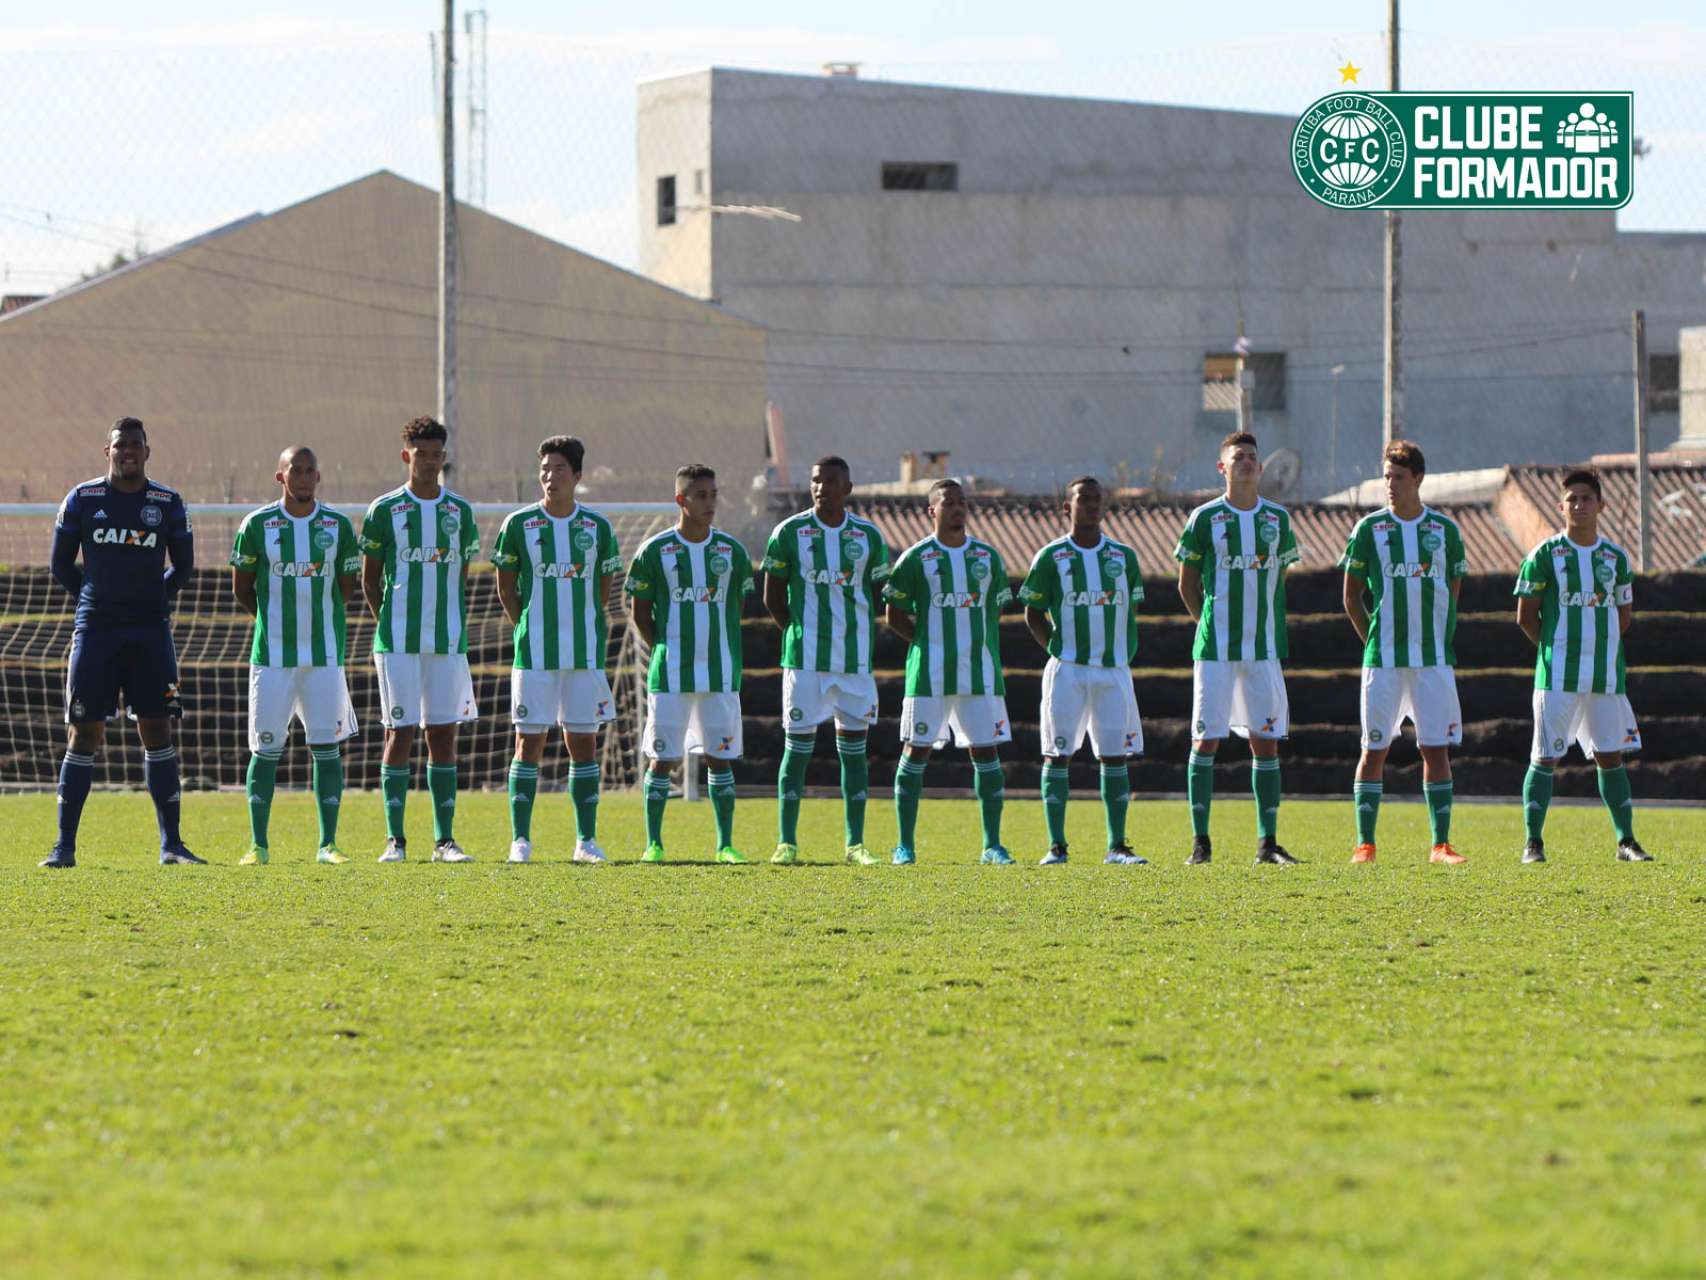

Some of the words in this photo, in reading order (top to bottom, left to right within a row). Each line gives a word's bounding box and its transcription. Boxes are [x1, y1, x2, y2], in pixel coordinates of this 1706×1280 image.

[92, 528, 158, 548] CAIXA
[401, 547, 457, 563] CAIXA
[1221, 554, 1276, 569] CAIXA
[272, 560, 331, 577] CAIXA
[534, 563, 593, 579] CAIXA
[1384, 562, 1441, 578] CAIXA
[805, 569, 861, 587] CAIXA
[671, 586, 725, 602] CAIXA
[1065, 591, 1124, 606] CAIXA
[1559, 591, 1616, 608] CAIXA
